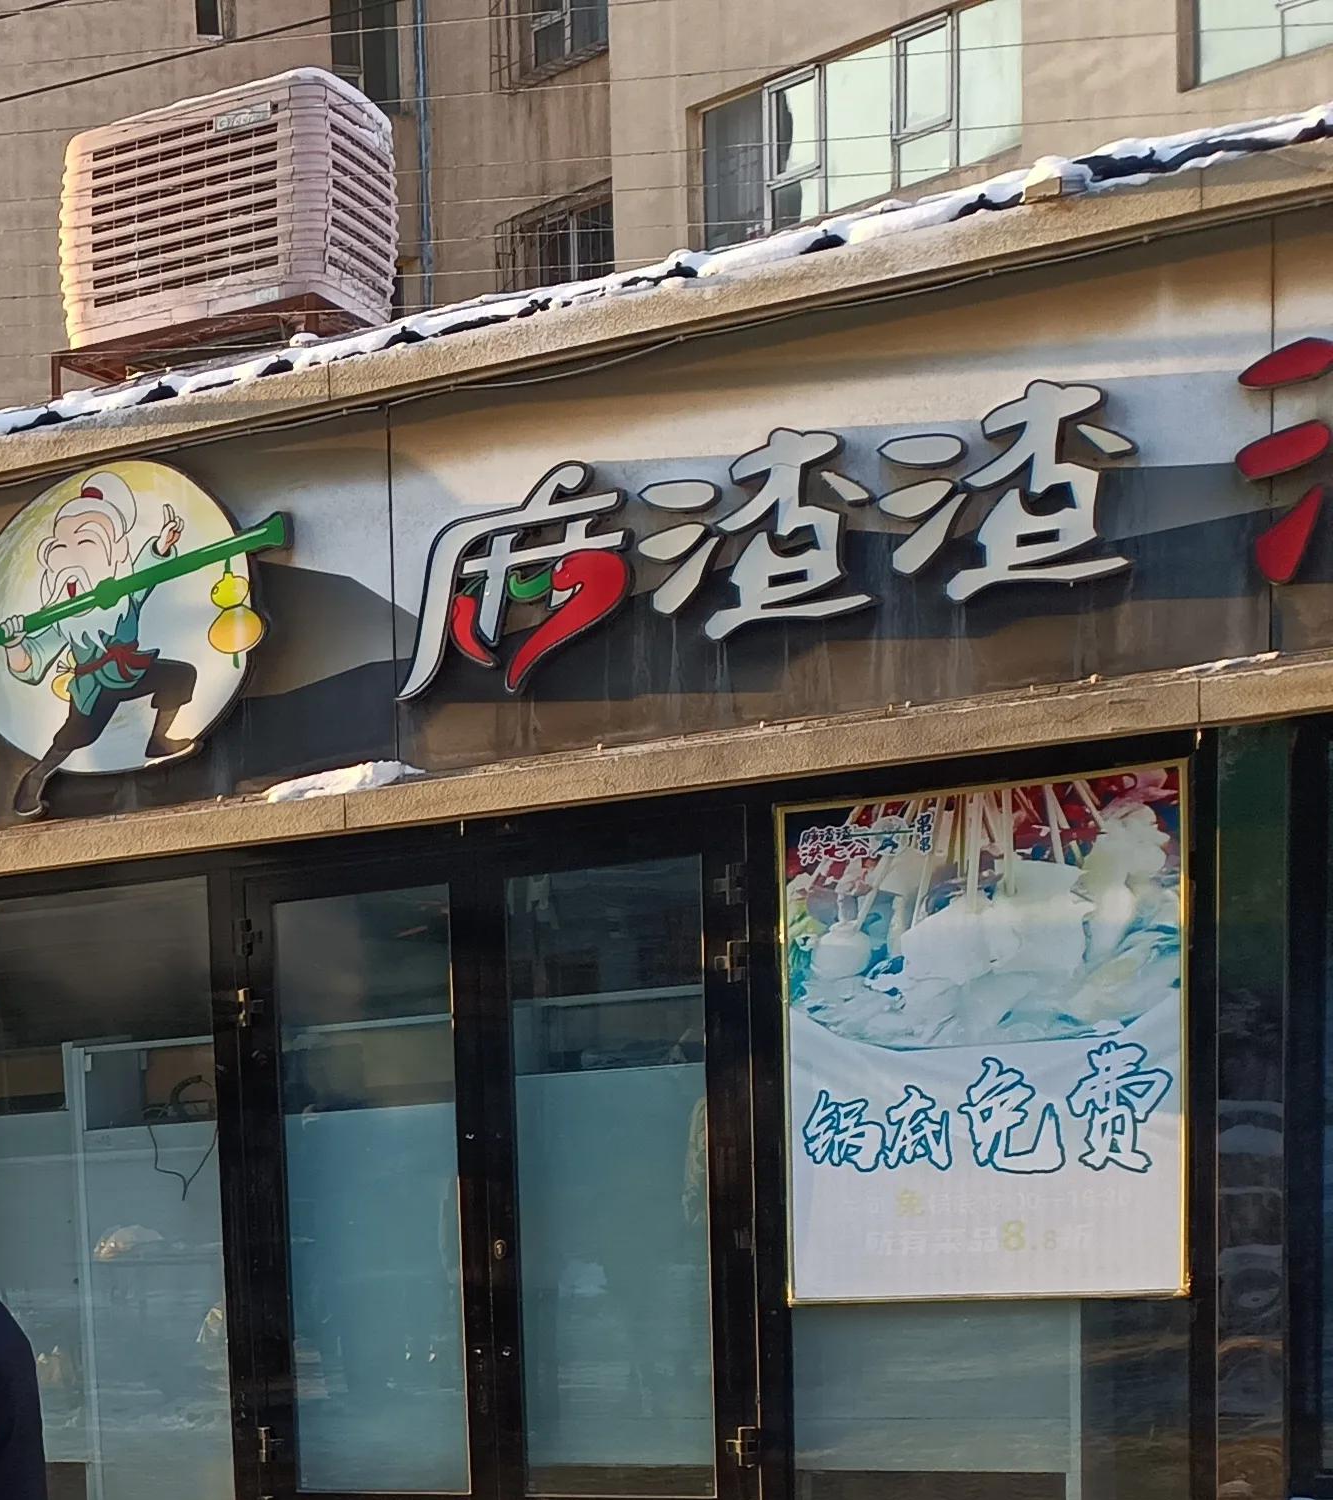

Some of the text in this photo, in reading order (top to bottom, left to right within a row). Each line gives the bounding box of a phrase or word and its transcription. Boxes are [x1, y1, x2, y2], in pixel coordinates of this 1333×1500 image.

[395, 378, 1137, 702] 麻渣渣
[802, 1041, 1173, 1174] 锅底免费
